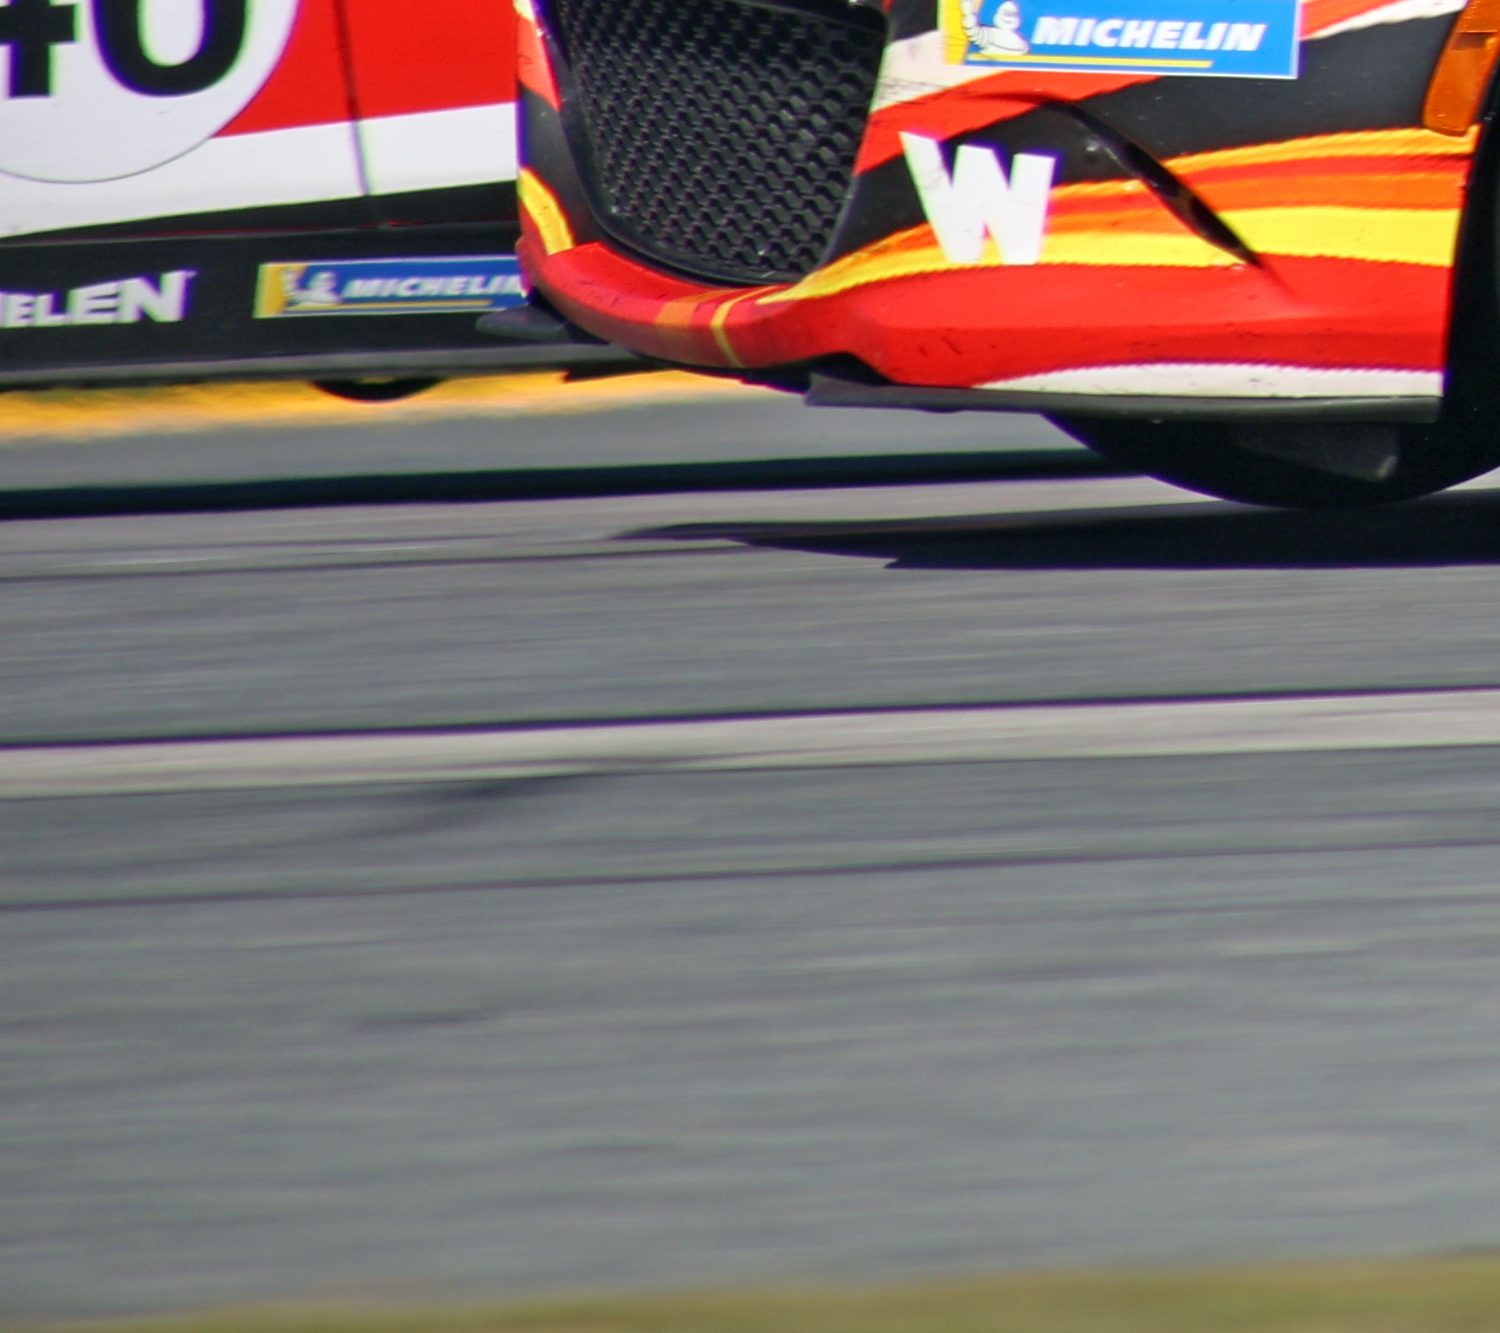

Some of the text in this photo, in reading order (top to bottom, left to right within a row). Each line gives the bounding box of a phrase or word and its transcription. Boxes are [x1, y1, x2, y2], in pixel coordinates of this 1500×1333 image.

[1033, 15, 1269, 52] MICHELIN
[900, 130, 1057, 265] W
[0, 270, 190, 328] ELEN
